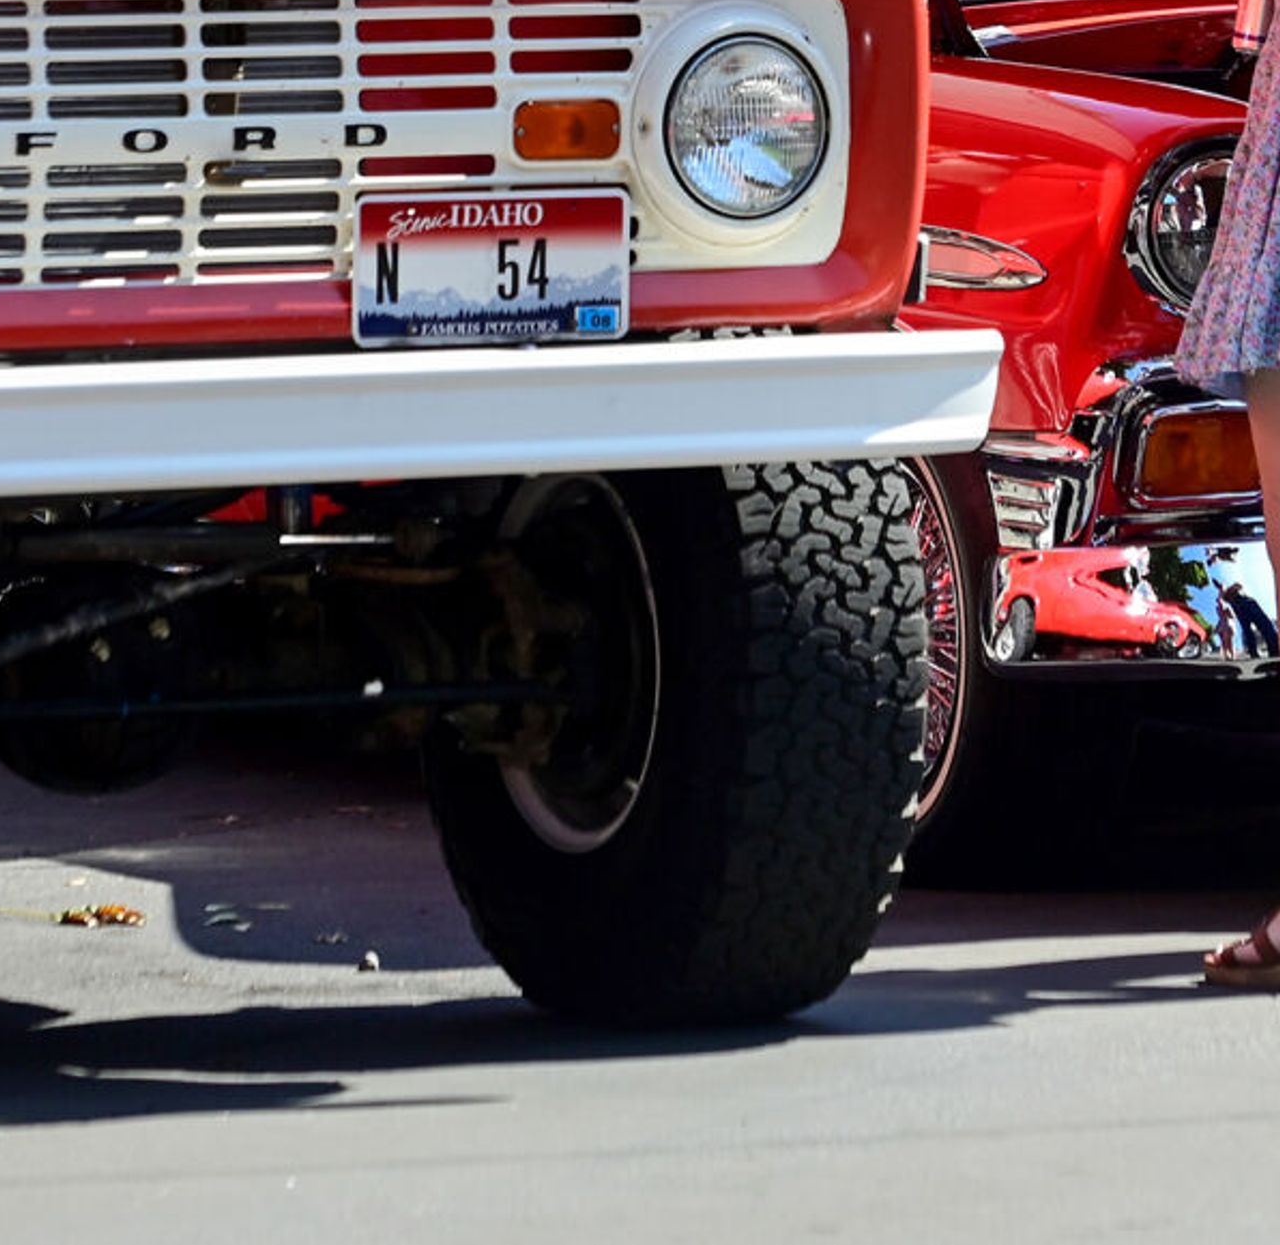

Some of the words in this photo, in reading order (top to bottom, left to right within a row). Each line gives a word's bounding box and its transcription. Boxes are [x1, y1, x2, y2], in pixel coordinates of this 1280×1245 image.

[14, 124, 388, 156] FORD
[387, 208, 451, 239] Scenic
[450, 202, 544, 229] IDAHO
[376, 242, 399, 304] N
[498, 238, 549, 302] 54
[421, 322, 481, 337] FAMOUS
[485, 319, 559, 335] POTATOES
